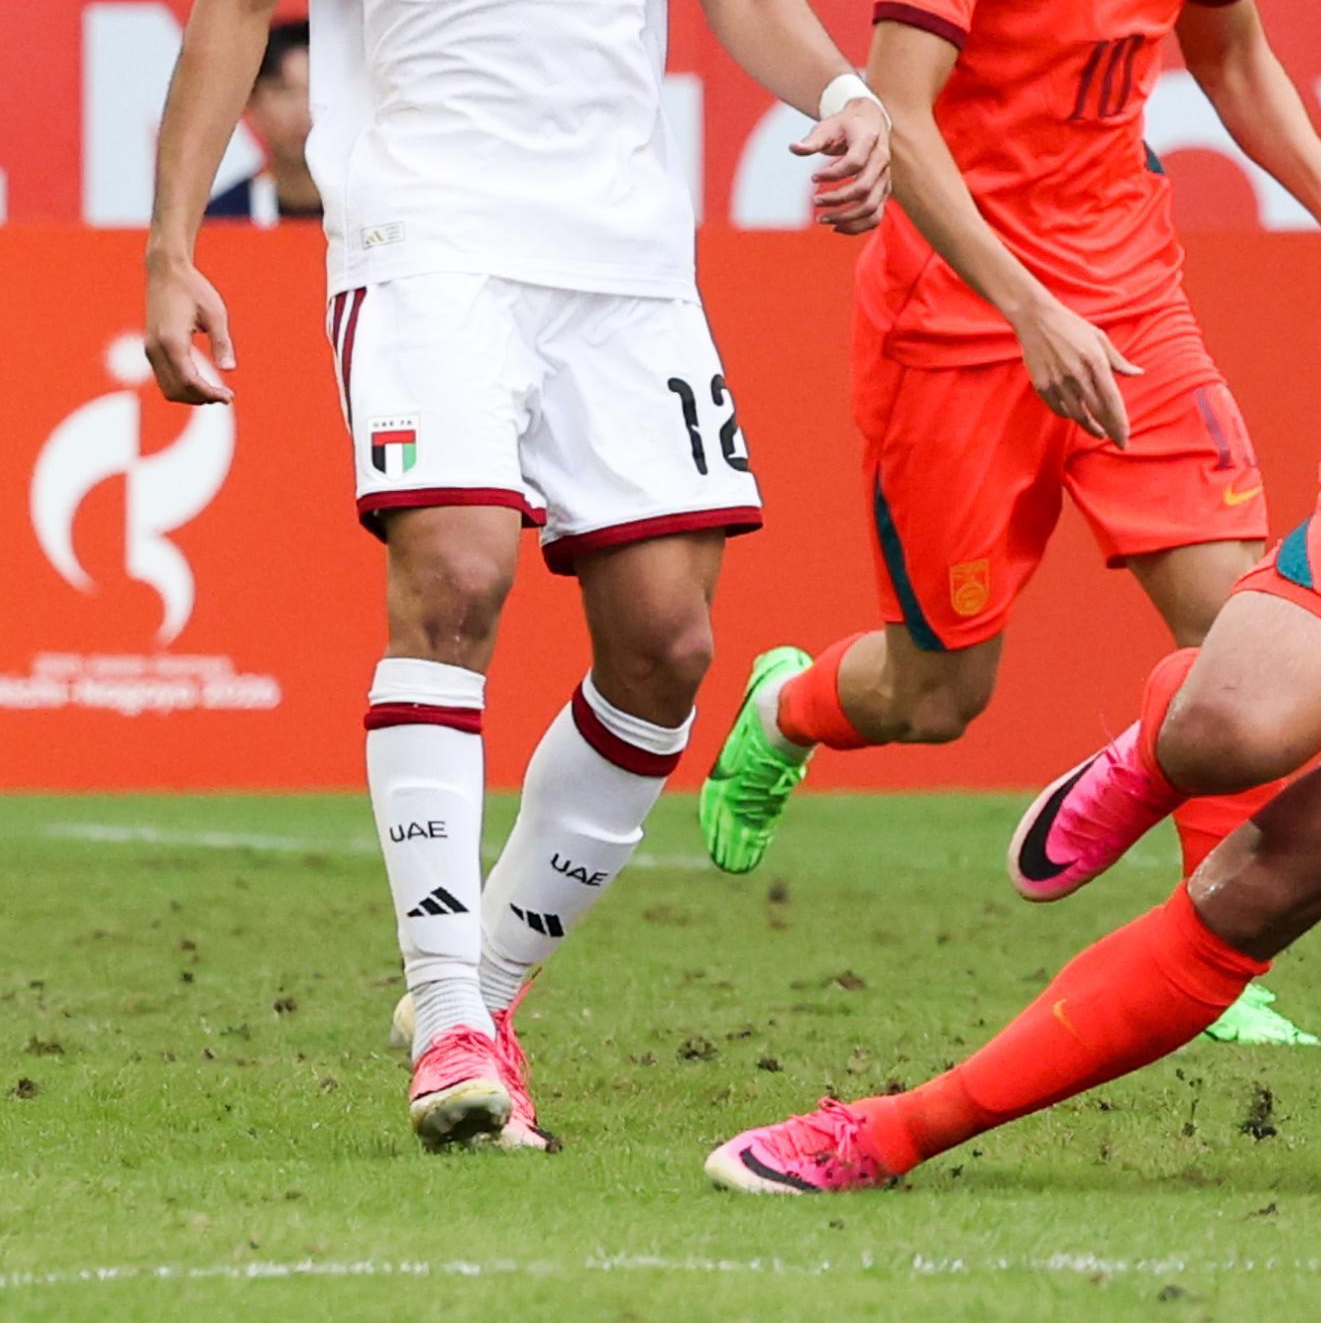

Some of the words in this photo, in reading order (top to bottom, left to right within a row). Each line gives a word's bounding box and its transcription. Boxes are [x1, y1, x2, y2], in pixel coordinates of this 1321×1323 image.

[1067, 33, 1146, 122] 10
[667, 373, 751, 476] 12
[388, 820, 449, 843] UAE
[549, 853, 609, 887] UAE
